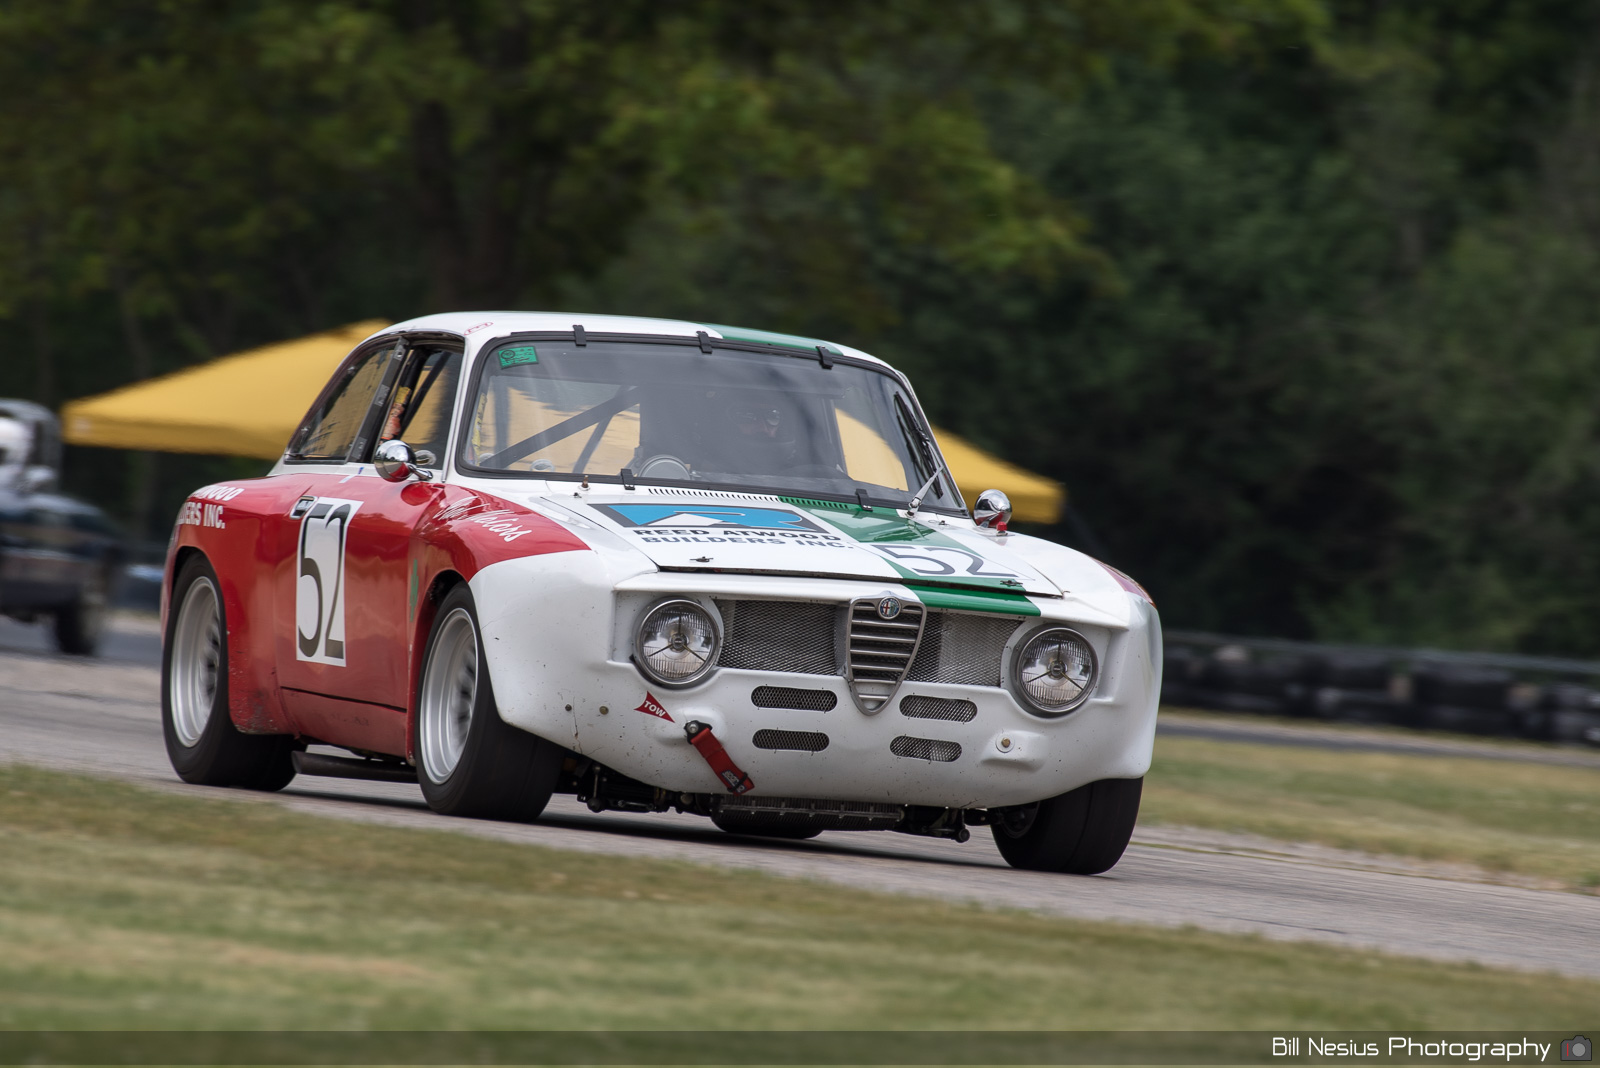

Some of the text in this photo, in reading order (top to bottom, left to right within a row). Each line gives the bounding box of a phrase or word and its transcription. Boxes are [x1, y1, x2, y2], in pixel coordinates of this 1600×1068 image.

[203, 503, 226, 529] INC.
[641, 537, 855, 549] BUILDERS INC.
[723, 530, 842, 541] ATWOOD
[870, 544, 1018, 577] 52
[298, 503, 351, 658] 52
[643, 700, 667, 718] TOW
